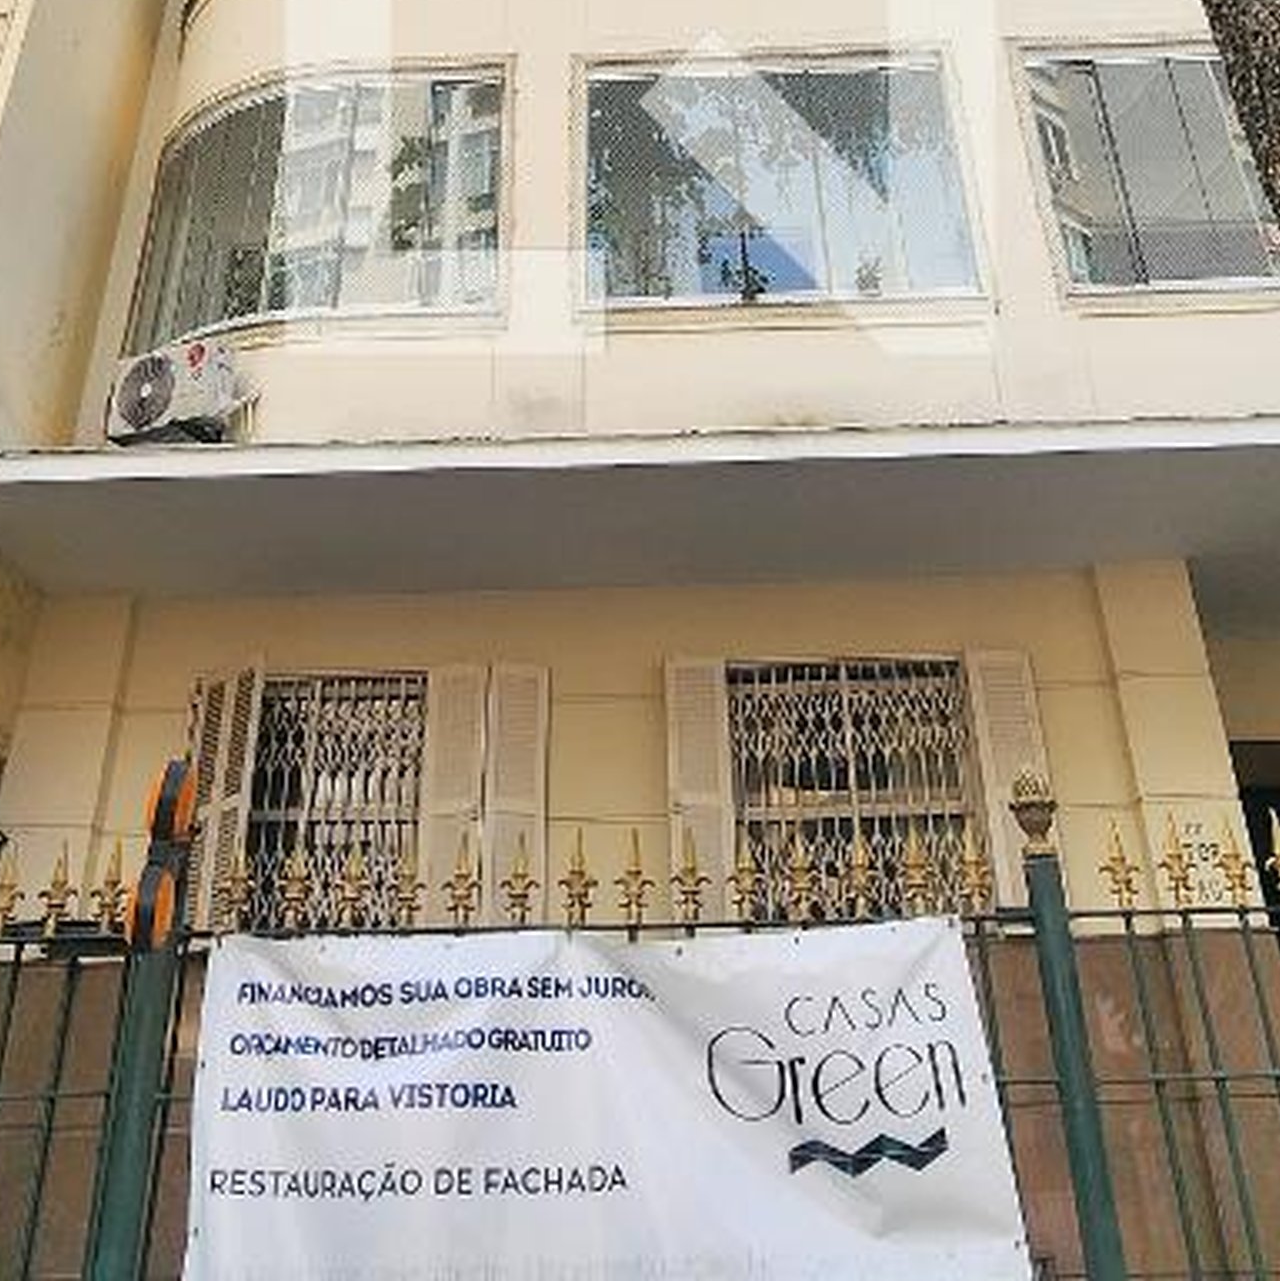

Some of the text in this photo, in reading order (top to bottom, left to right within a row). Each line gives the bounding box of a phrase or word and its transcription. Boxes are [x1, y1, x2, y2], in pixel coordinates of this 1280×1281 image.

[237, 981, 393, 1009] FINANCIAMOS
[400, 979, 449, 1005] SUA
[454, 976, 522, 1000] OBRA
[527, 976, 572, 999] SEM
[784, 983, 947, 1036] CASAS
[360, 1028, 486, 1061] DETALHADO
[488, 1027, 592, 1054] GRATUITO
[708, 1026, 966, 1125] Green
[221, 1083, 518, 1113] LAUDO PARA VISTORIA
[211, 1162, 628, 1202] RESTAURAÇÃO DE FACHADA
